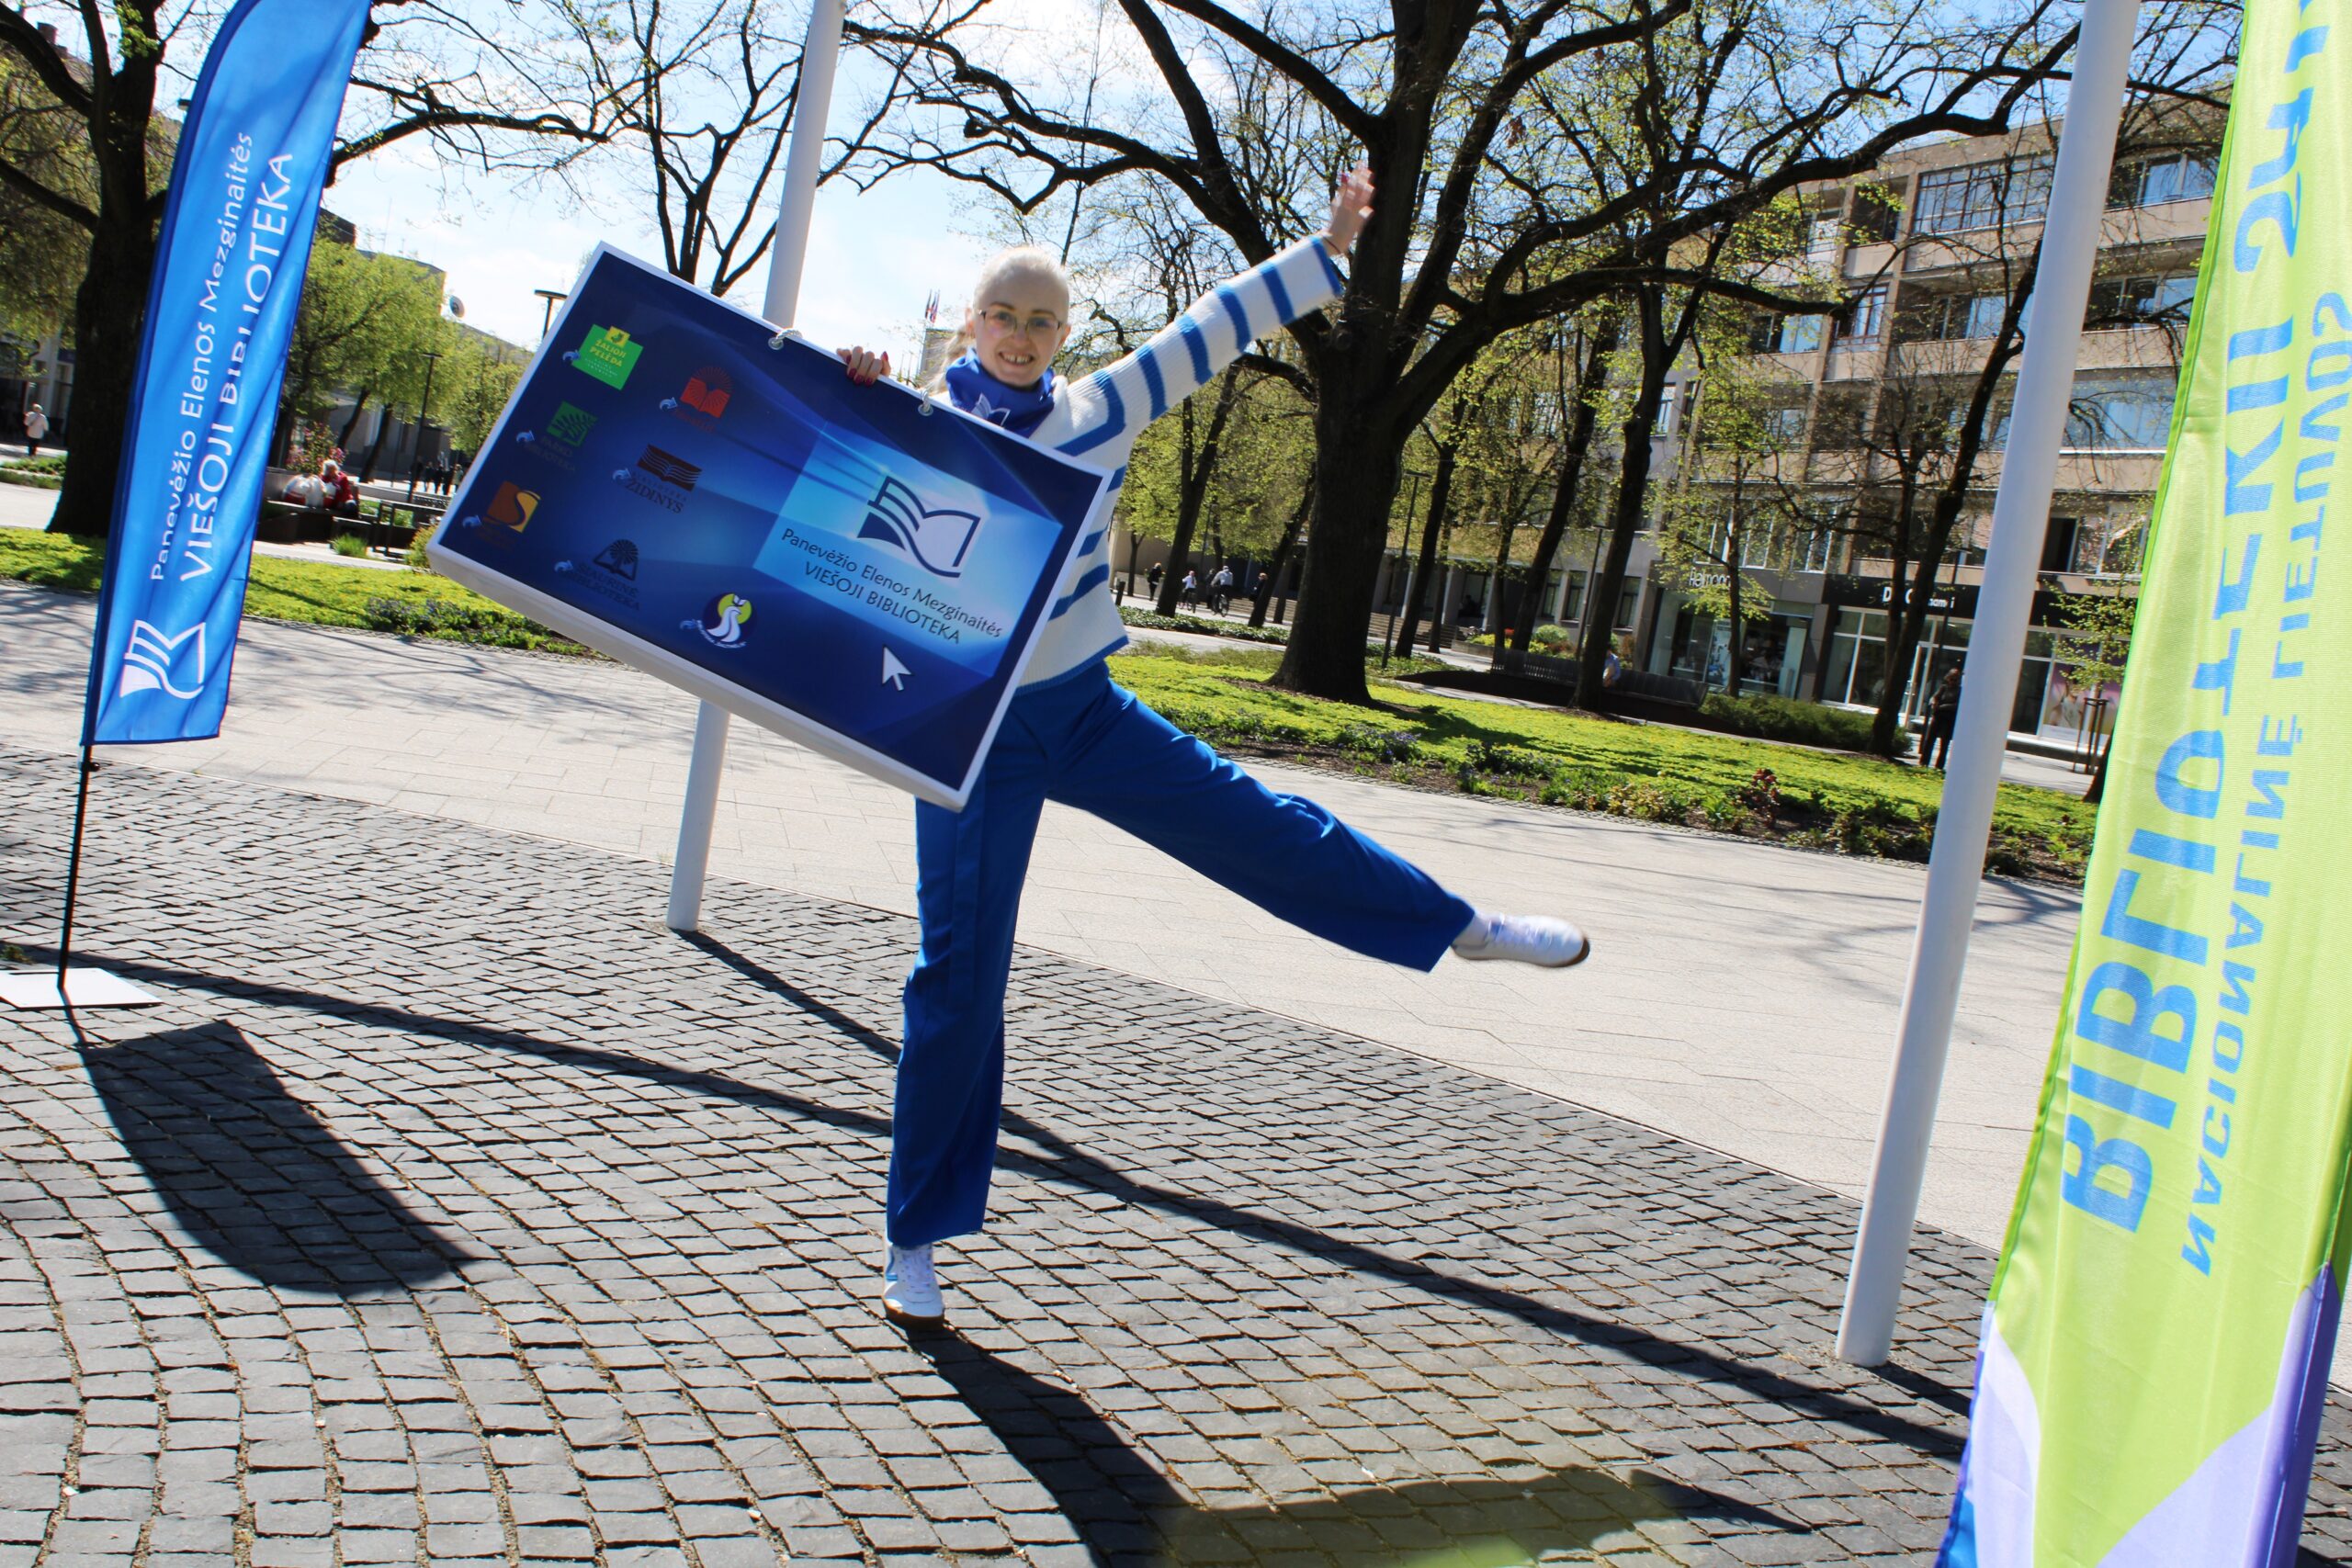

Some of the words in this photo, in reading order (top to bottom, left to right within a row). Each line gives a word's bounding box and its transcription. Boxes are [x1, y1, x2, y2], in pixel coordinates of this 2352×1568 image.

[151, 430, 197, 581] Panevėžio
[180, 321, 216, 418] Elenos
[198, 132, 253, 312] Mezginaitės
[179, 423, 235, 581] VIEŠOJI
[781, 527, 857, 572] Panevėžio
[861, 564, 910, 596] Elenos
[912, 588, 1003, 638] Mezginaitės
[805, 560, 865, 599] VIEŠOJI
[865, 591, 960, 645] BIBLIOTEKA
